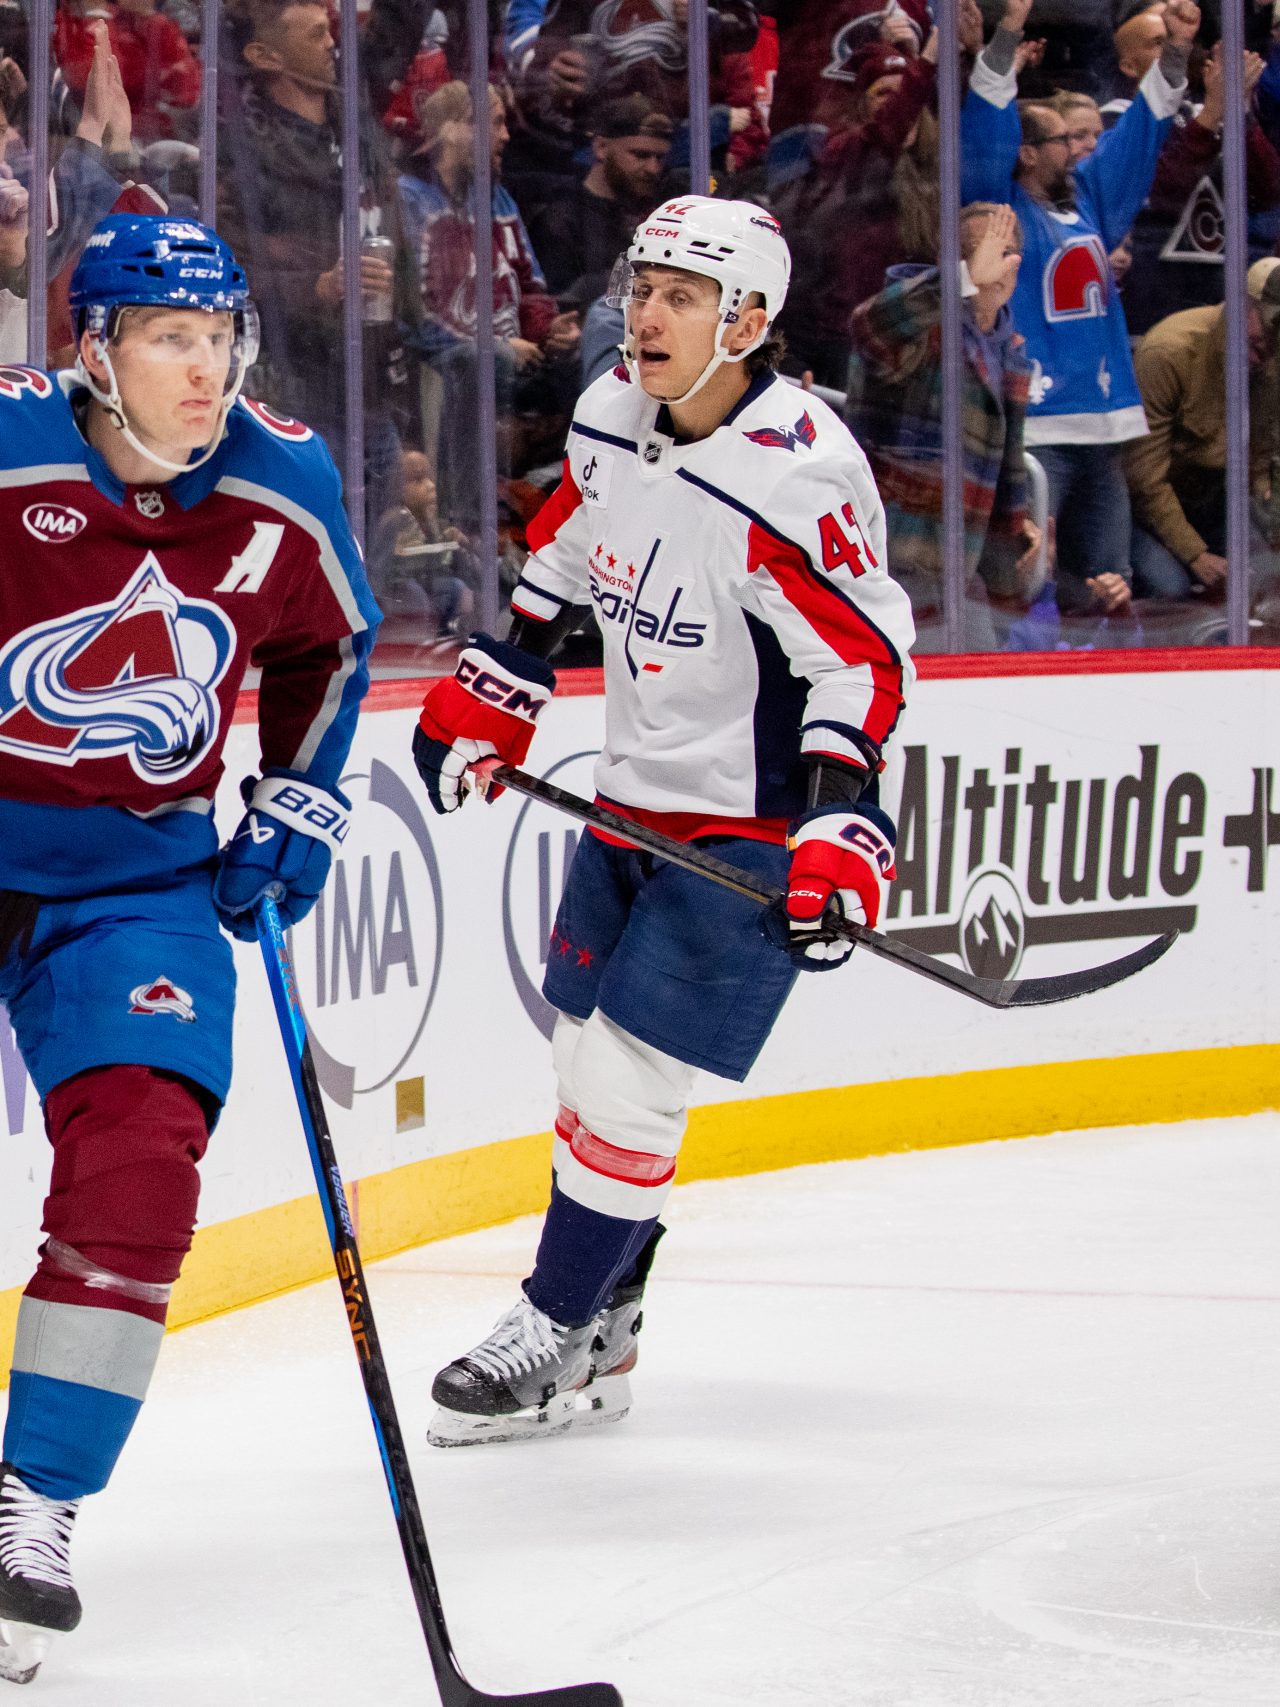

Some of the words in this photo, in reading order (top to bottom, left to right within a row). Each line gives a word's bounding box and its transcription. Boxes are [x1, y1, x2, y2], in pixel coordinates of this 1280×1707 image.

[644, 227, 680, 239] CCM
[664, 204, 697, 216] 42
[178, 267, 224, 280] CCM
[33, 508, 77, 534] IMA
[213, 520, 286, 594] A
[588, 537, 708, 682] apitals
[454, 657, 548, 721] CCM
[885, 743, 1207, 920] Altitude
[787, 889, 823, 900] CCM
[314, 850, 419, 1009] IMA
[334, 1248, 371, 1362] SYNC
